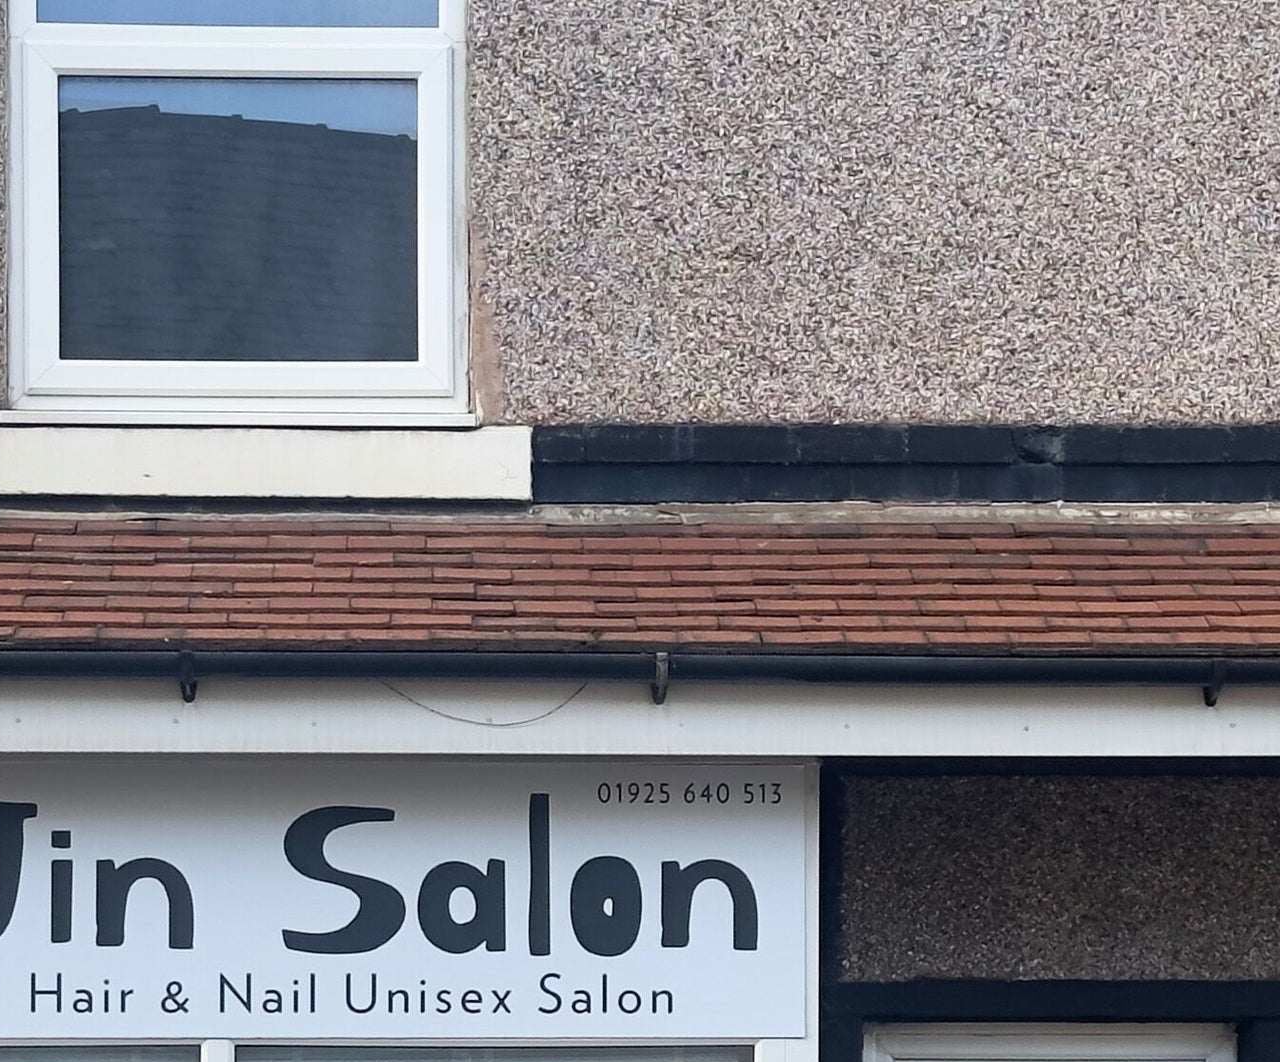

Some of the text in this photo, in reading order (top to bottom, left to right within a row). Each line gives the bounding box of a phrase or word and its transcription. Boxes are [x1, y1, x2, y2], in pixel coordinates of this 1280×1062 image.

[597, 782, 783, 804] 01925 640 513
[282, 791, 758, 956] Salon
[30, 972, 674, 1014] Hair & Nail Unisex Salon
